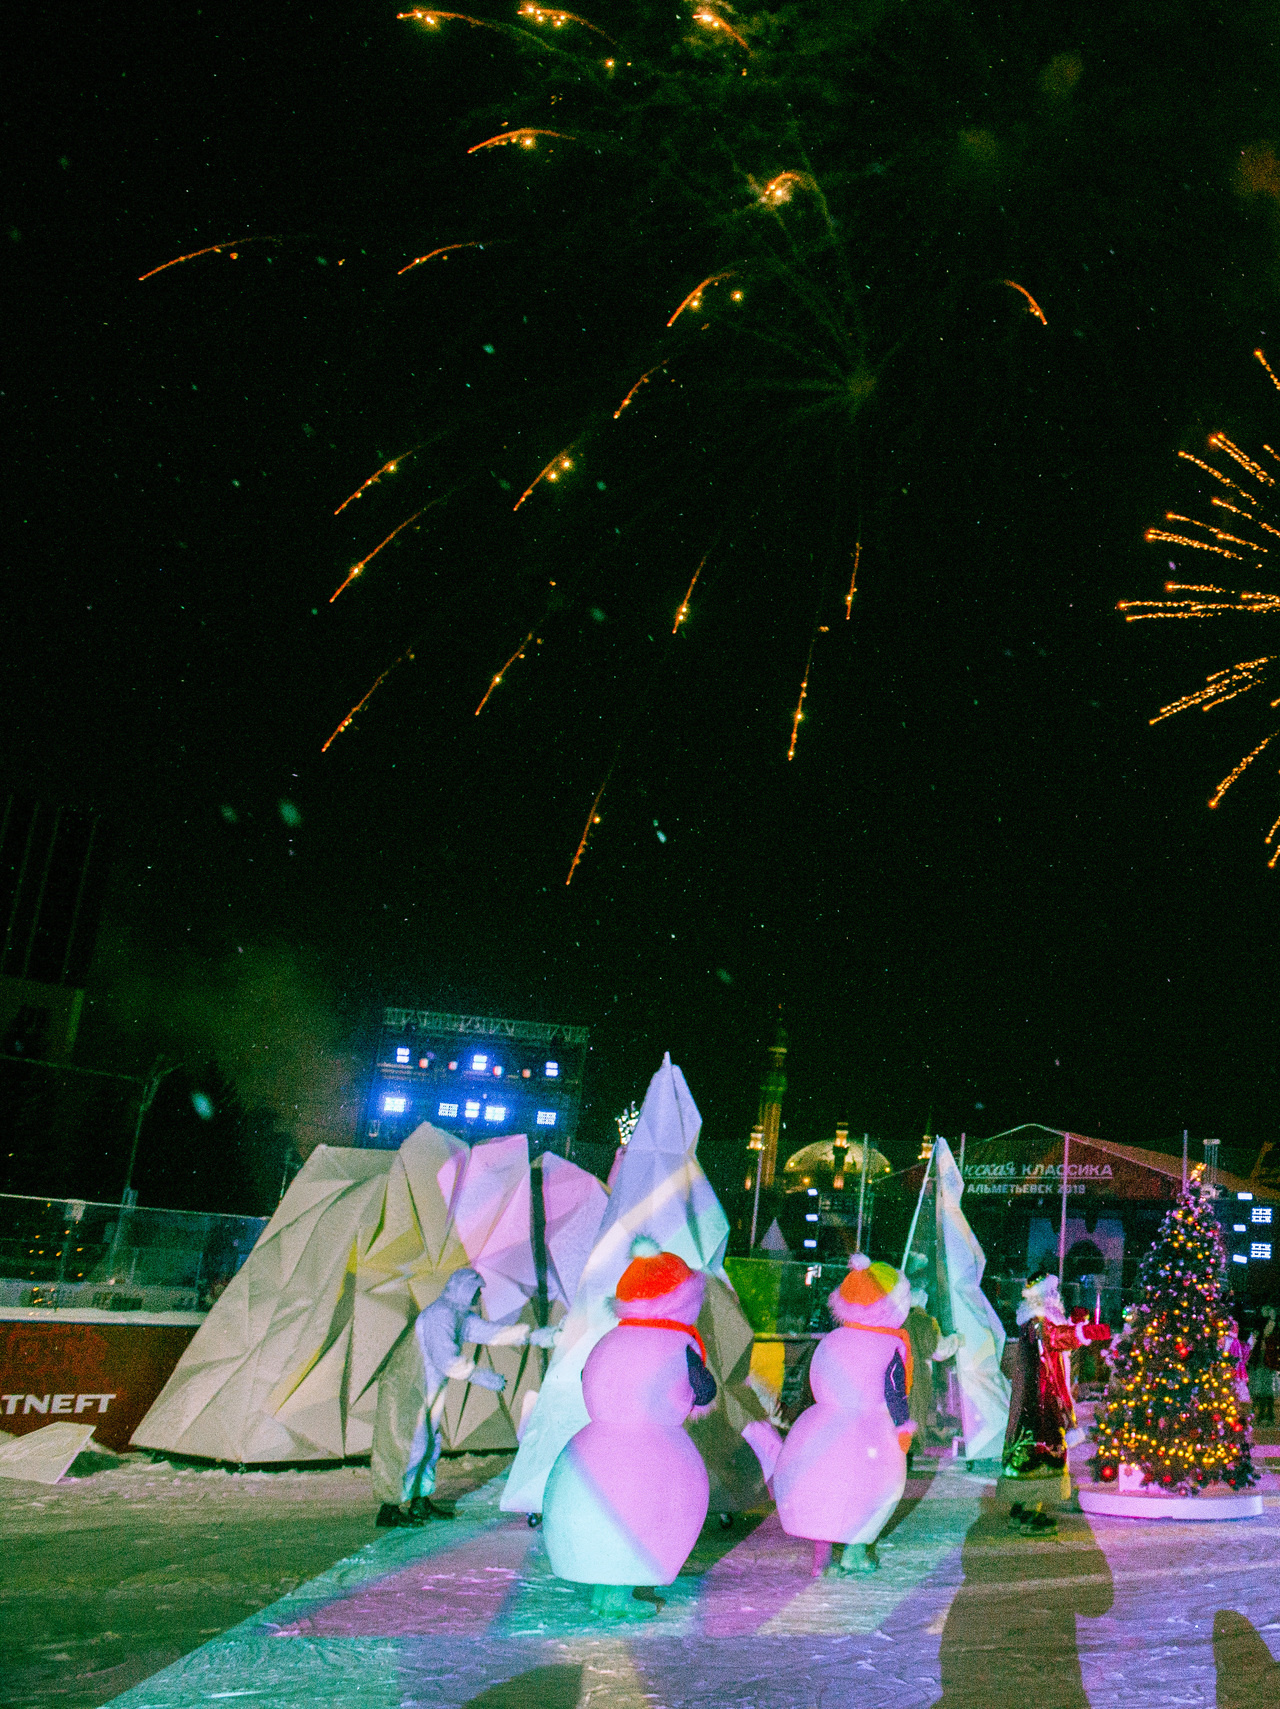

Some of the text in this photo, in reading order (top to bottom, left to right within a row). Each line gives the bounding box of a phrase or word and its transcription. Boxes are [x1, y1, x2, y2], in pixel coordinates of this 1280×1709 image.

[964, 1161, 1113, 1176] сская КЛАССИКА
[967, 1184, 1053, 1194] АЛЬМЕТЬЕВСК
[0, 1393, 116, 1415] TNEFT
